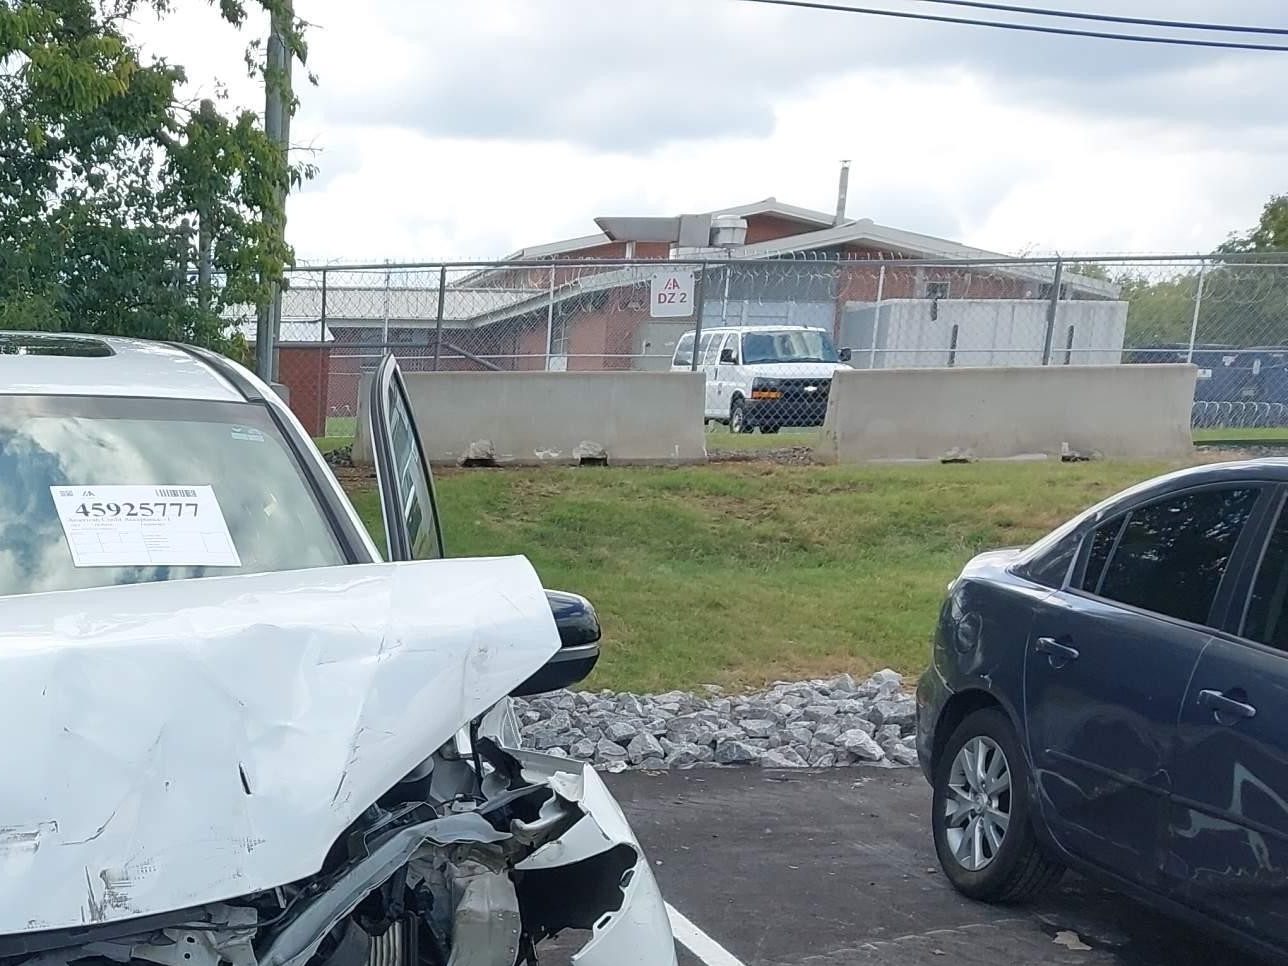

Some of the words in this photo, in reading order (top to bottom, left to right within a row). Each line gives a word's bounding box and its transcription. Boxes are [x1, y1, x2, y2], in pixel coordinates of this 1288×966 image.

[658, 293, 675, 304] DZ
[679, 292, 687, 303] 2
[75, 502, 199, 518] 45925777
